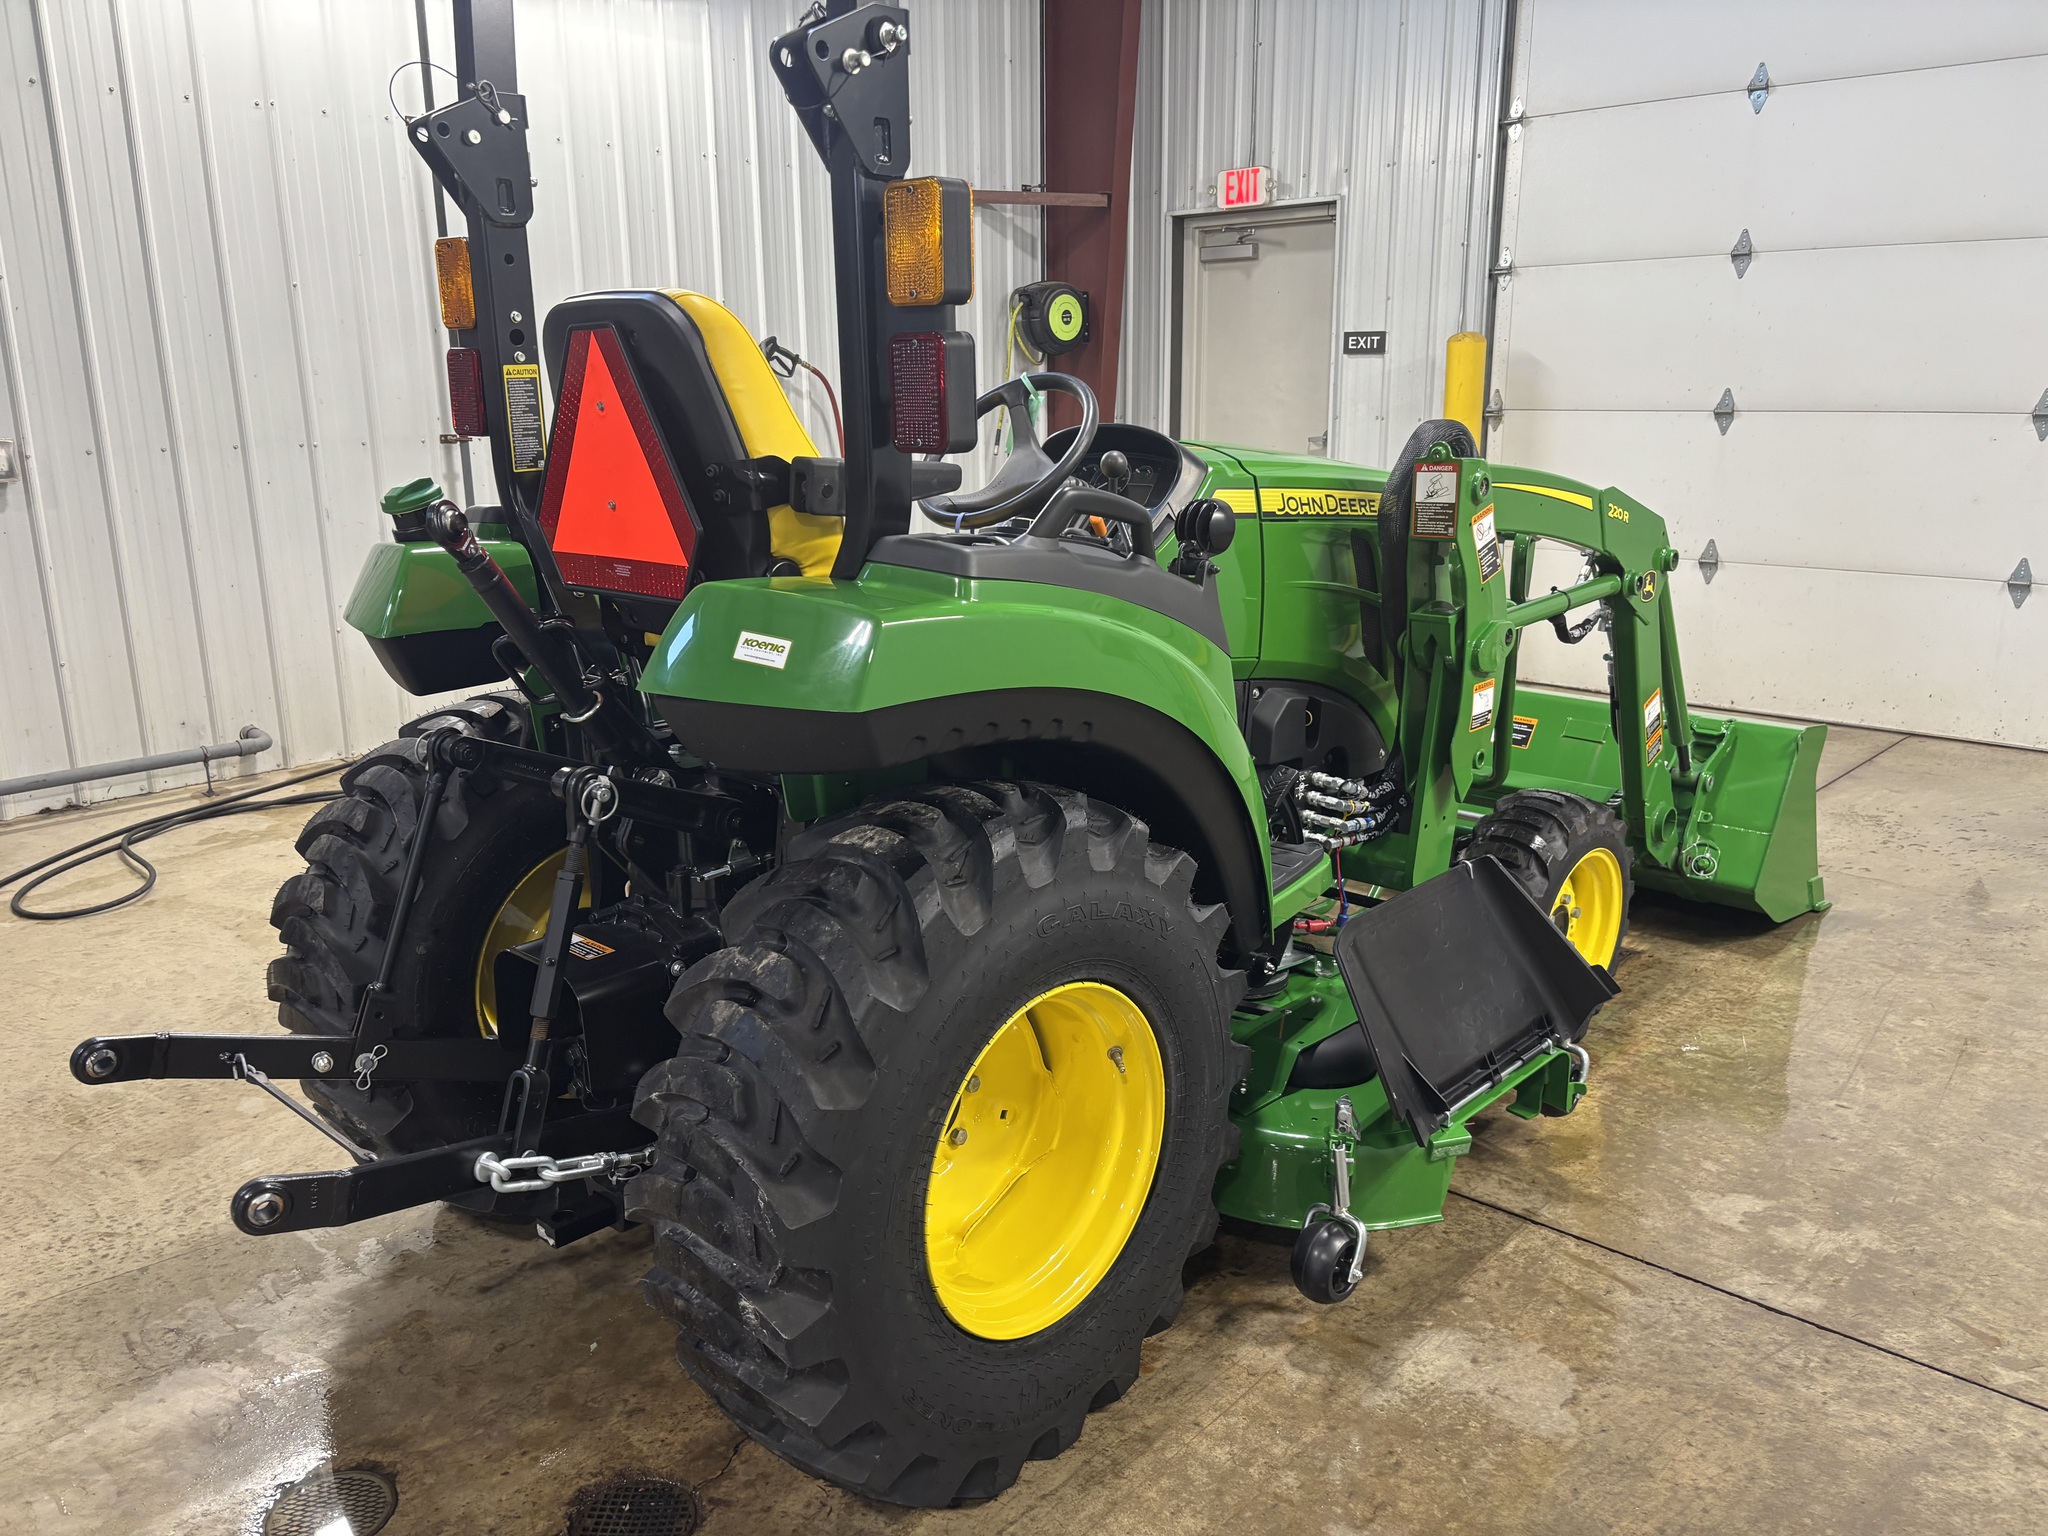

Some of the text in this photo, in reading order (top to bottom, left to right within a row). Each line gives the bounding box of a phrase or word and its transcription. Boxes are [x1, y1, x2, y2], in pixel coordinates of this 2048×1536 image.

[1225, 168, 1260, 205] EXIT
[1348, 336, 1380, 349] EXIT
[512, 368, 538, 376] CAUTION
[1277, 493, 1378, 514] JOHN DEERE
[1608, 503, 1629, 524] 220R
[1036, 900, 1176, 940] GALAXY
